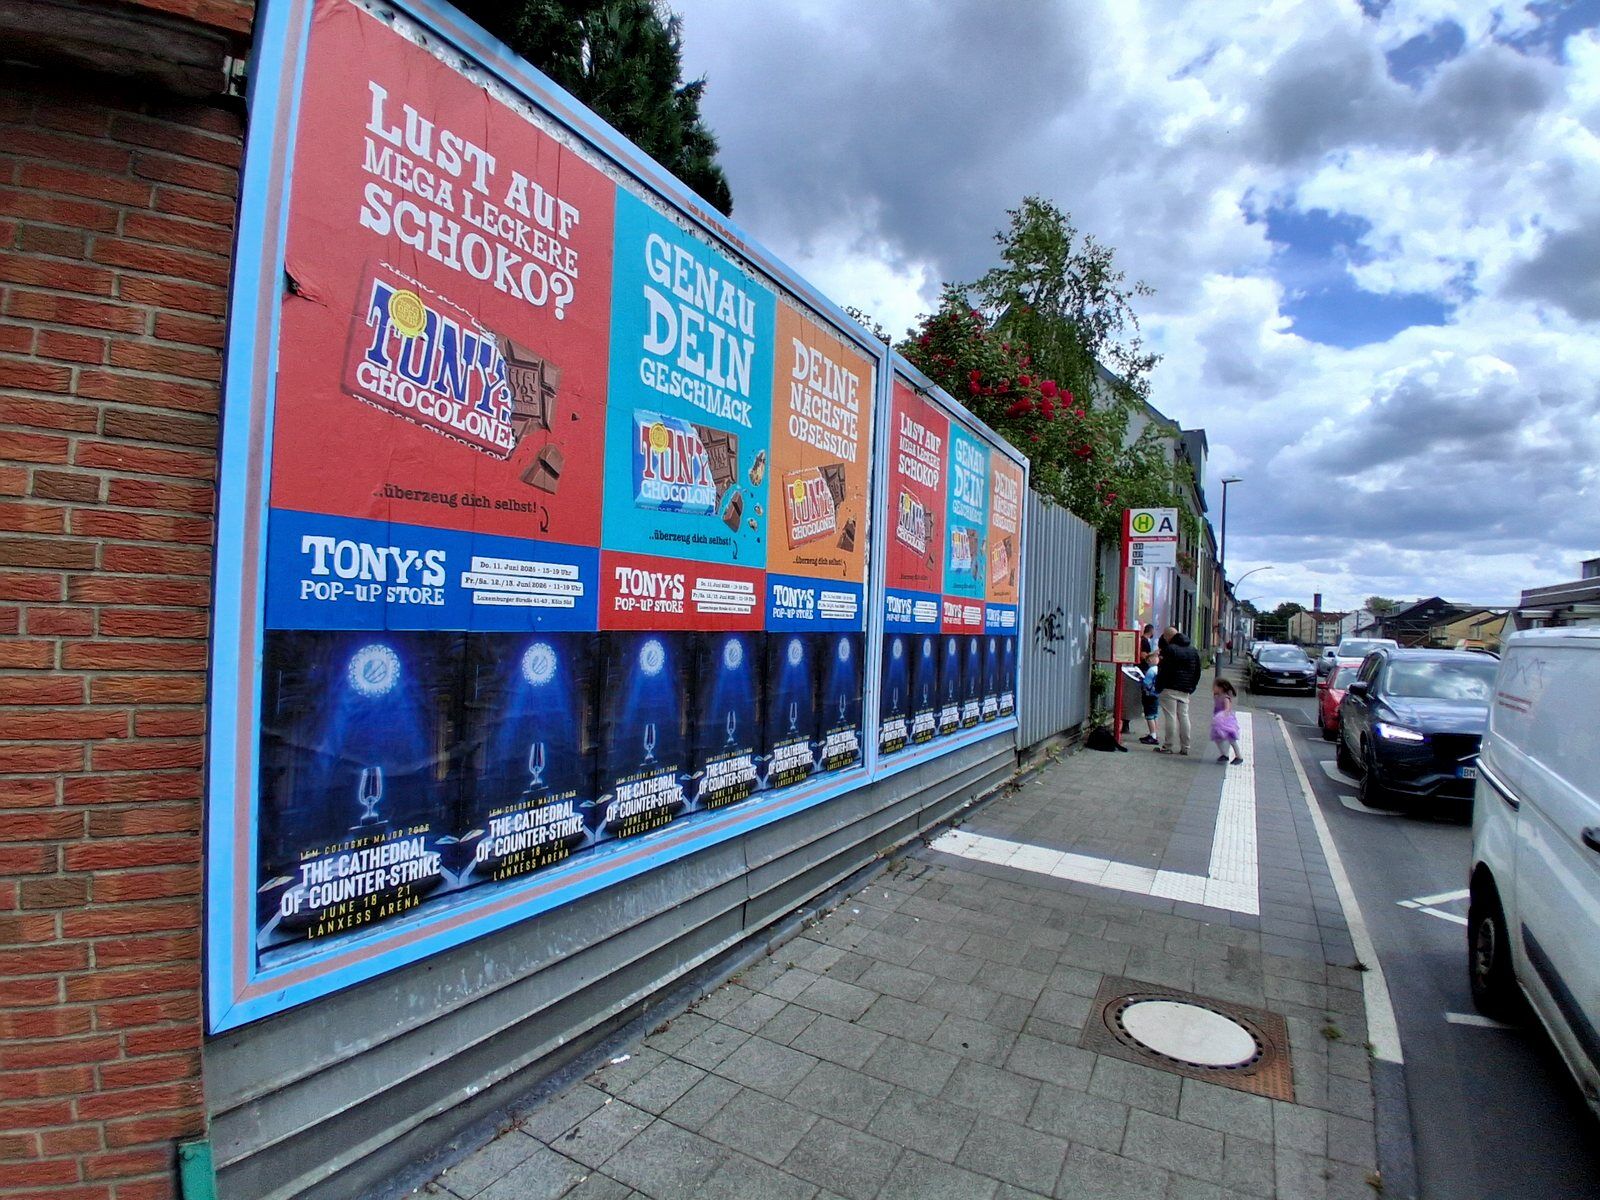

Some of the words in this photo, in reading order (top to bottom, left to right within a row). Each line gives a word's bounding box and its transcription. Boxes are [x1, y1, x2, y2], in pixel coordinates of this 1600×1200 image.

[365, 79, 496, 196] LUST
[504, 170, 580, 240] AUF
[362, 136, 454, 212] MEGA
[462, 189, 579, 279] LECKERE
[359, 183, 574, 320] SCHOKO?
[645, 233, 756, 338] GENAU
[643, 285, 755, 397] DEIN
[640, 357, 752, 428] GESCHMACK
[792, 337, 860, 415] DEINE
[790, 381, 858, 441] NÄCHSTE
[788, 414, 856, 464] OBSESSION
[900, 411, 925, 445] LUST
[925, 429, 941, 454] AUF
[898, 454, 939, 491] SCHOKO?
[955, 438, 984, 478] GENAU
[461, 493, 491, 509] dich
[494, 497, 537, 513] selbst!
[954, 464, 984, 509] DEIN
[692, 532, 707, 544] dich
[708, 535, 732, 546] selbst!
[1138, 516, 1148, 529] H
[1158, 517, 1173, 532] A
[301, 534, 446, 586] TONY'S
[480, 561, 491, 569] Do.
[493, 562, 502, 570] 11.
[504, 563, 519, 571] Juni
[387, 587, 445, 606] STORE
[516, 580, 531, 588] Juni
[615, 567, 685, 600] TONY'S
[773, 584, 814, 609] TONY'S
[654, 600, 684, 613] STORE
[796, 609, 814, 620] STORE
[887, 596, 912, 615] TONY'S
[699, 780, 708, 795] OF
[709, 766, 757, 792] COUNTER-STRIKE
[706, 763, 719, 778] THE
[720, 754, 752, 775] CATHEDRAL
[1464, 768, 1476, 777] BM
[606, 805, 618, 822] OF
[619, 786, 683, 818] COUNTER-STRIKE
[616, 784, 632, 802] THE
[634, 773, 676, 799] CATHEDRAL
[489, 815, 512, 838] THE
[514, 800, 574, 832] CATHEDRAL
[624, 814, 641, 827] JUNE
[652, 814, 672, 827] ARENA
[325, 837, 368, 854] COLOGNE
[373, 829, 403, 844] MAJOR
[476, 841, 492, 863] OF
[494, 815, 584, 857] COUNTER-STRIKE
[501, 851, 525, 867] JUNE
[531, 846, 541, 858] 18
[554, 840, 564, 850] 21
[300, 857, 333, 887] THE
[338, 836, 427, 877] CATHEDRAL
[493, 858, 537, 881] LANXESS
[541, 849, 569, 865] ARENA
[281, 888, 305, 917] OF
[309, 854, 442, 909] COUNTER-STRIKE
[320, 900, 355, 921] JUNE
[363, 894, 377, 908] 18
[397, 884, 411, 898] 21
[308, 910, 372, 939] LANXESS
[379, 895, 420, 917] ARENA
